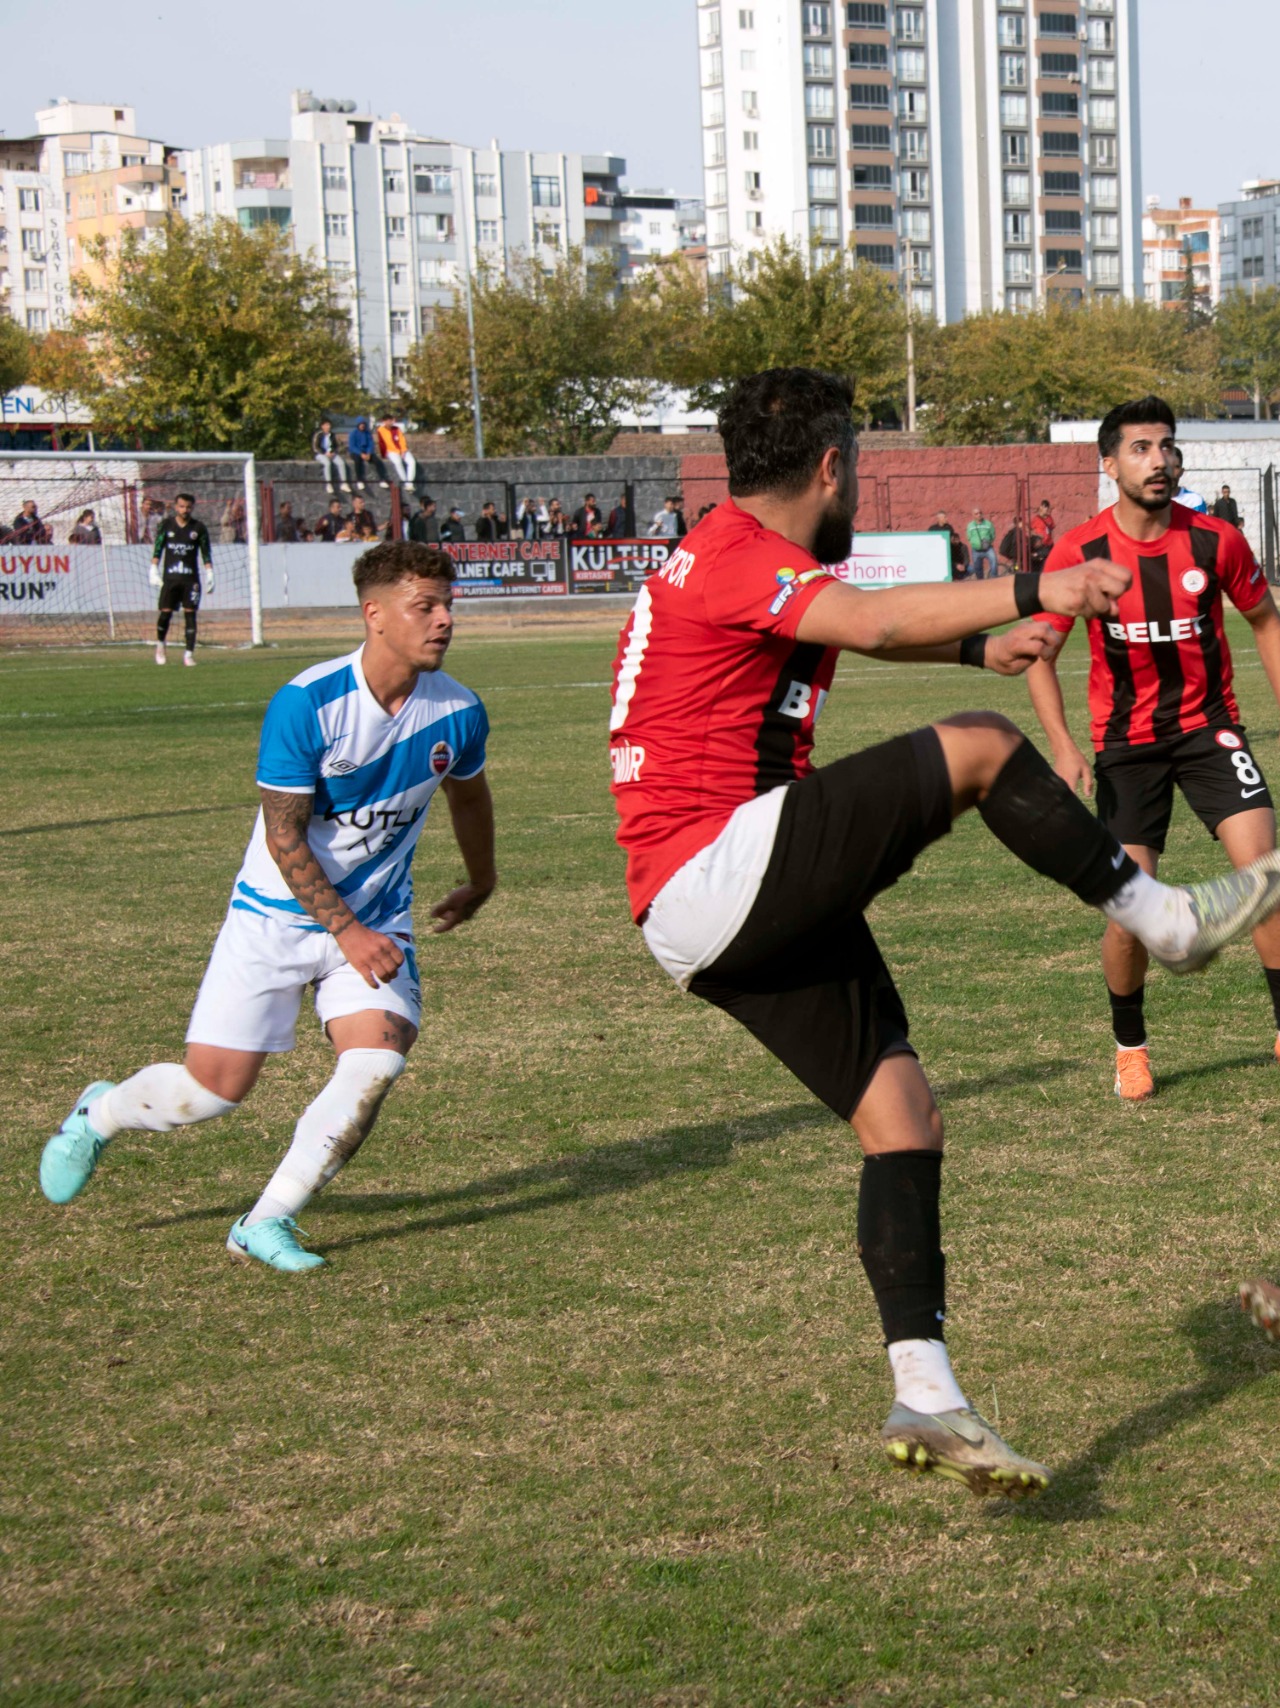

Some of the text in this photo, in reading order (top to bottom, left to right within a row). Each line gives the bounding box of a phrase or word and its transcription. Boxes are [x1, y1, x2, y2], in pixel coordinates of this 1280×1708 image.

[520, 541, 561, 560] CAFE
[572, 545, 669, 571] KÜLTÜR
[492, 561, 525, 577] CAFE
[854, 562, 907, 579] home
[1230, 750, 1261, 785] 8
